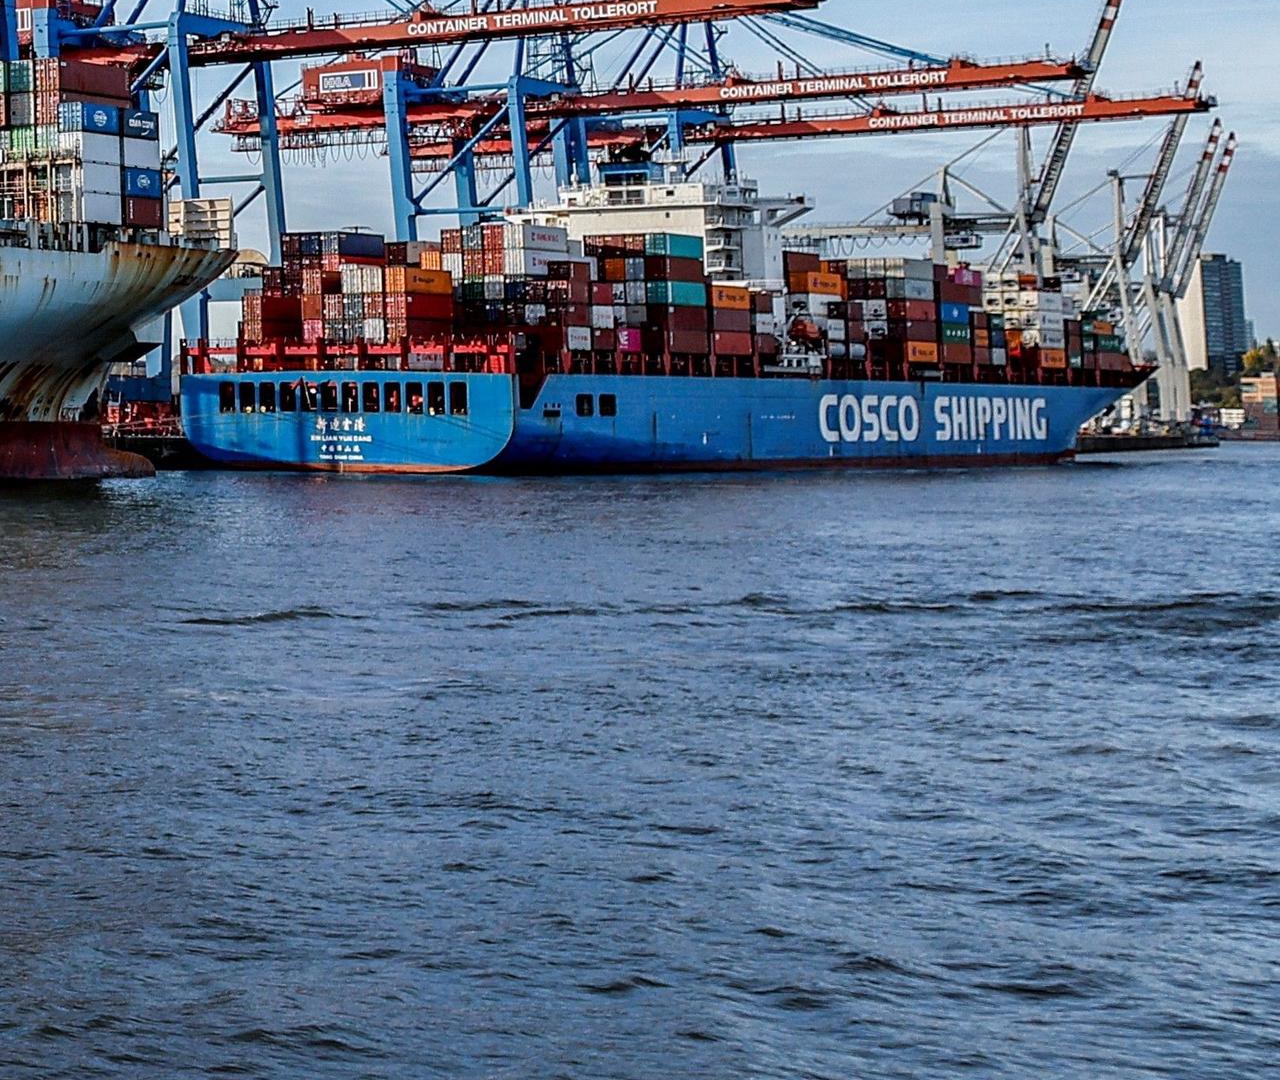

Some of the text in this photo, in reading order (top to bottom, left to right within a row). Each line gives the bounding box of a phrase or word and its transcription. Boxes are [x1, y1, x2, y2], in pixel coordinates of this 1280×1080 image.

[407, 0, 658, 36] CONTAINER TERMINAL TOLLERORT
[720, 70, 948, 99] CONTAINER TERMINAL TOLLERORT
[868, 104, 1084, 128] CONTAINER TERMINAL TOLLERORT
[819, 394, 1049, 442] COSCO SHIPPING
